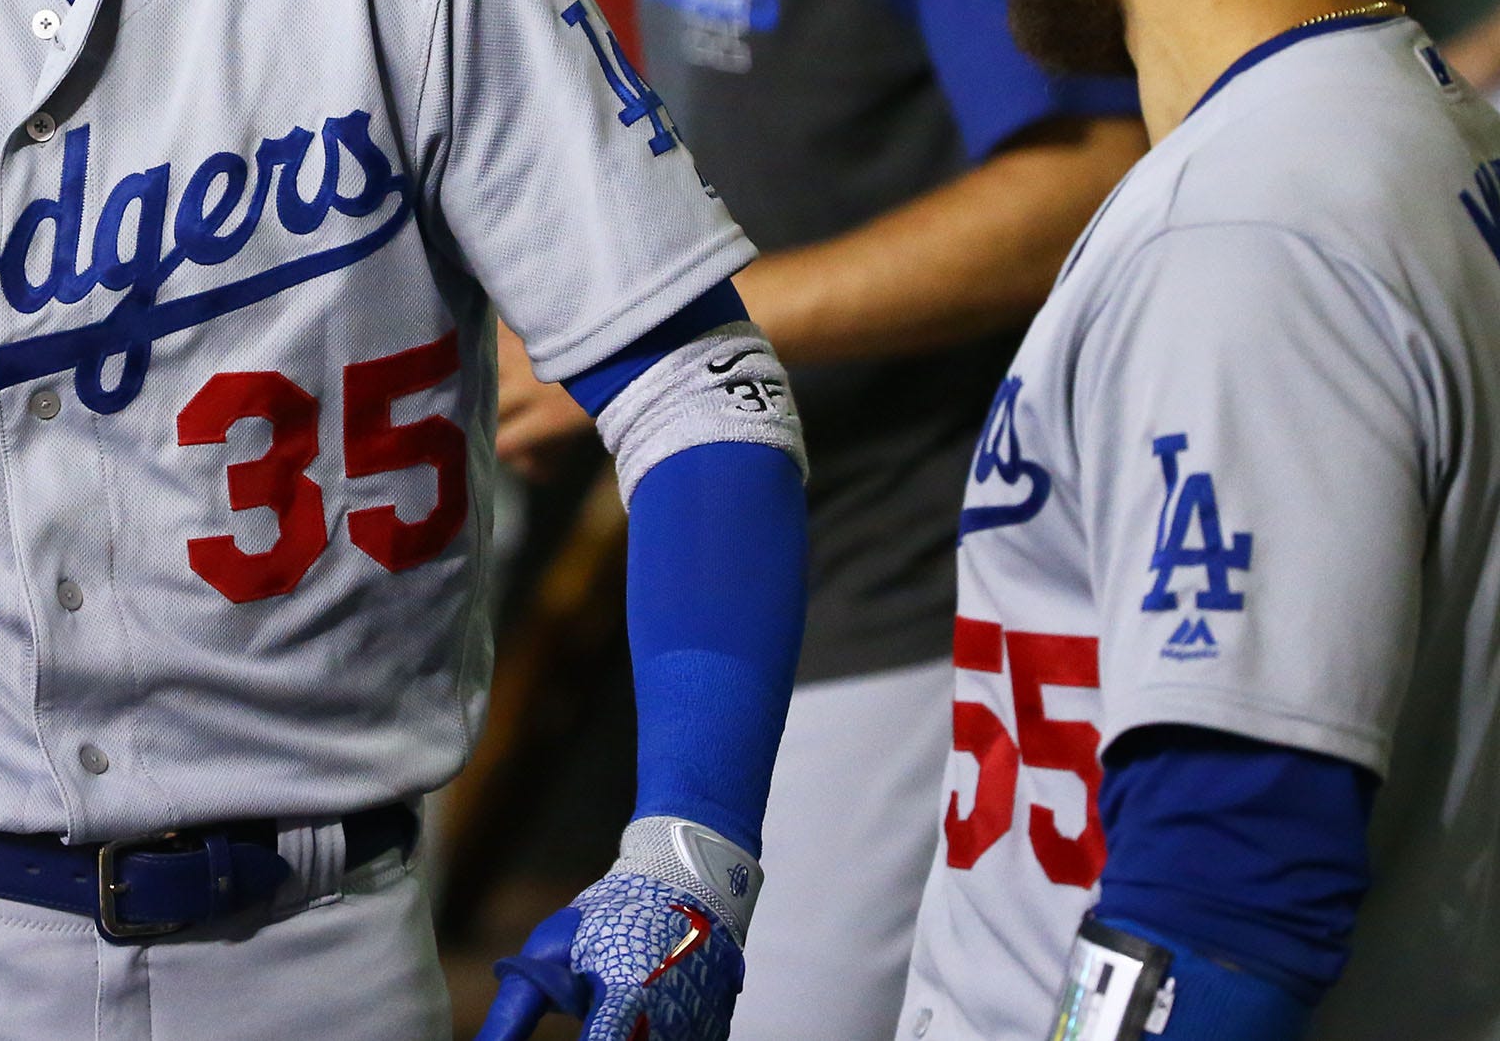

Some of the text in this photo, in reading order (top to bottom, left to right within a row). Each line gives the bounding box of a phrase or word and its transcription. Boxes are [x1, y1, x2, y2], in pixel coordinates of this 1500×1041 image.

[176, 328, 469, 605] 35
[1140, 432, 1253, 613] LA
[943, 613, 1109, 891] 55
